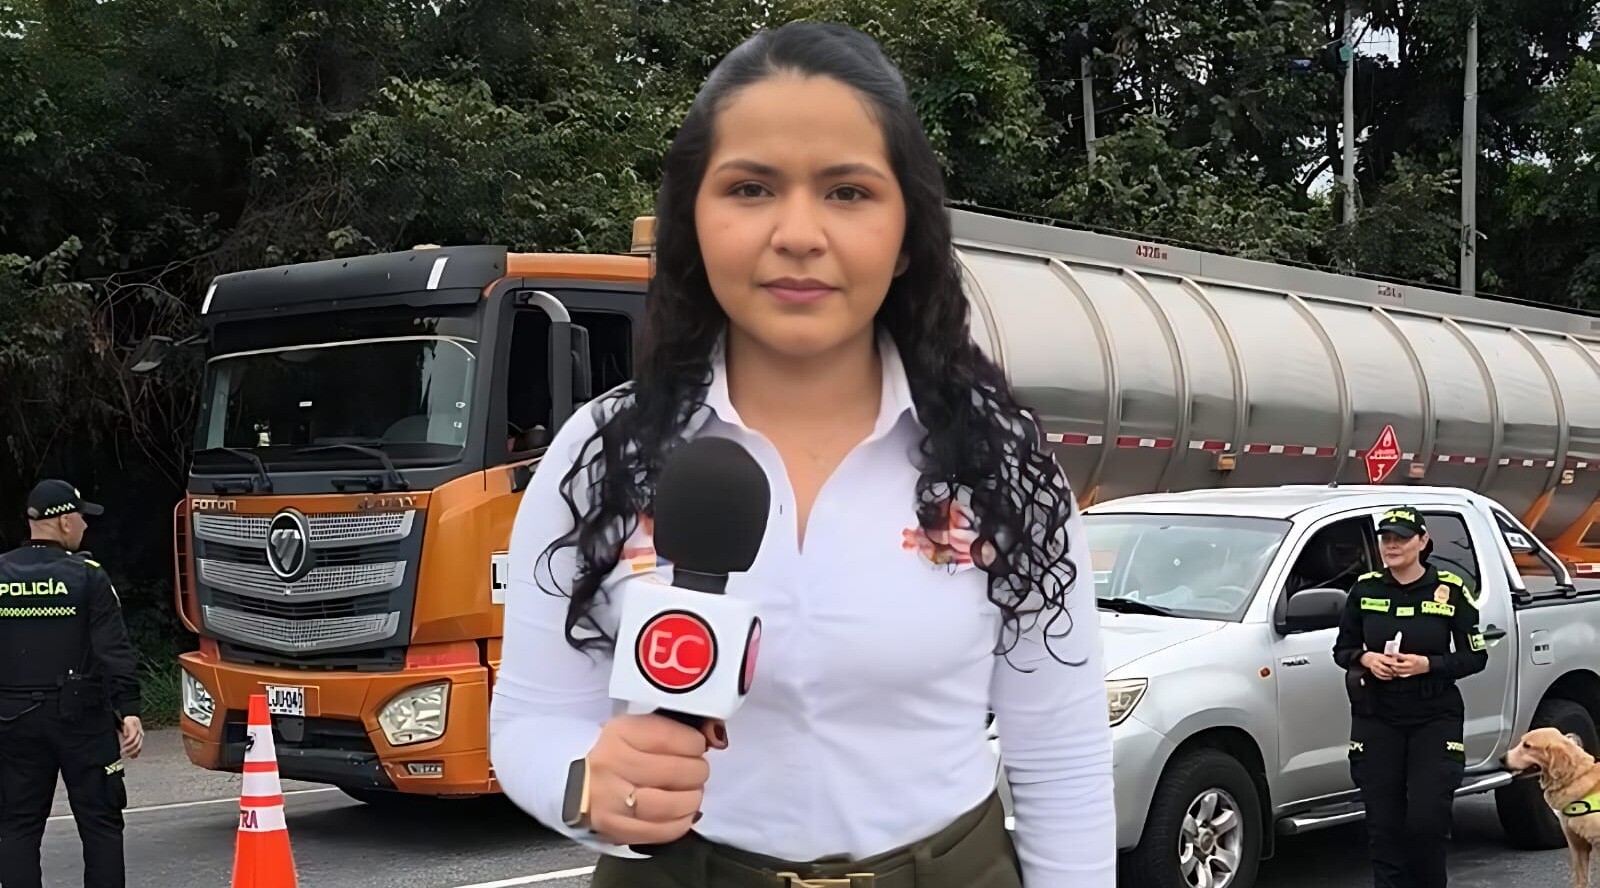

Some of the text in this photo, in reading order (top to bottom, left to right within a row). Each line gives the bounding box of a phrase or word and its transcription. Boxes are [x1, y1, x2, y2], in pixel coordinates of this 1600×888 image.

[192, 499, 237, 511] FOTON
[0, 577, 69, 597] POLICÍA
[648, 629, 705, 675] EC
